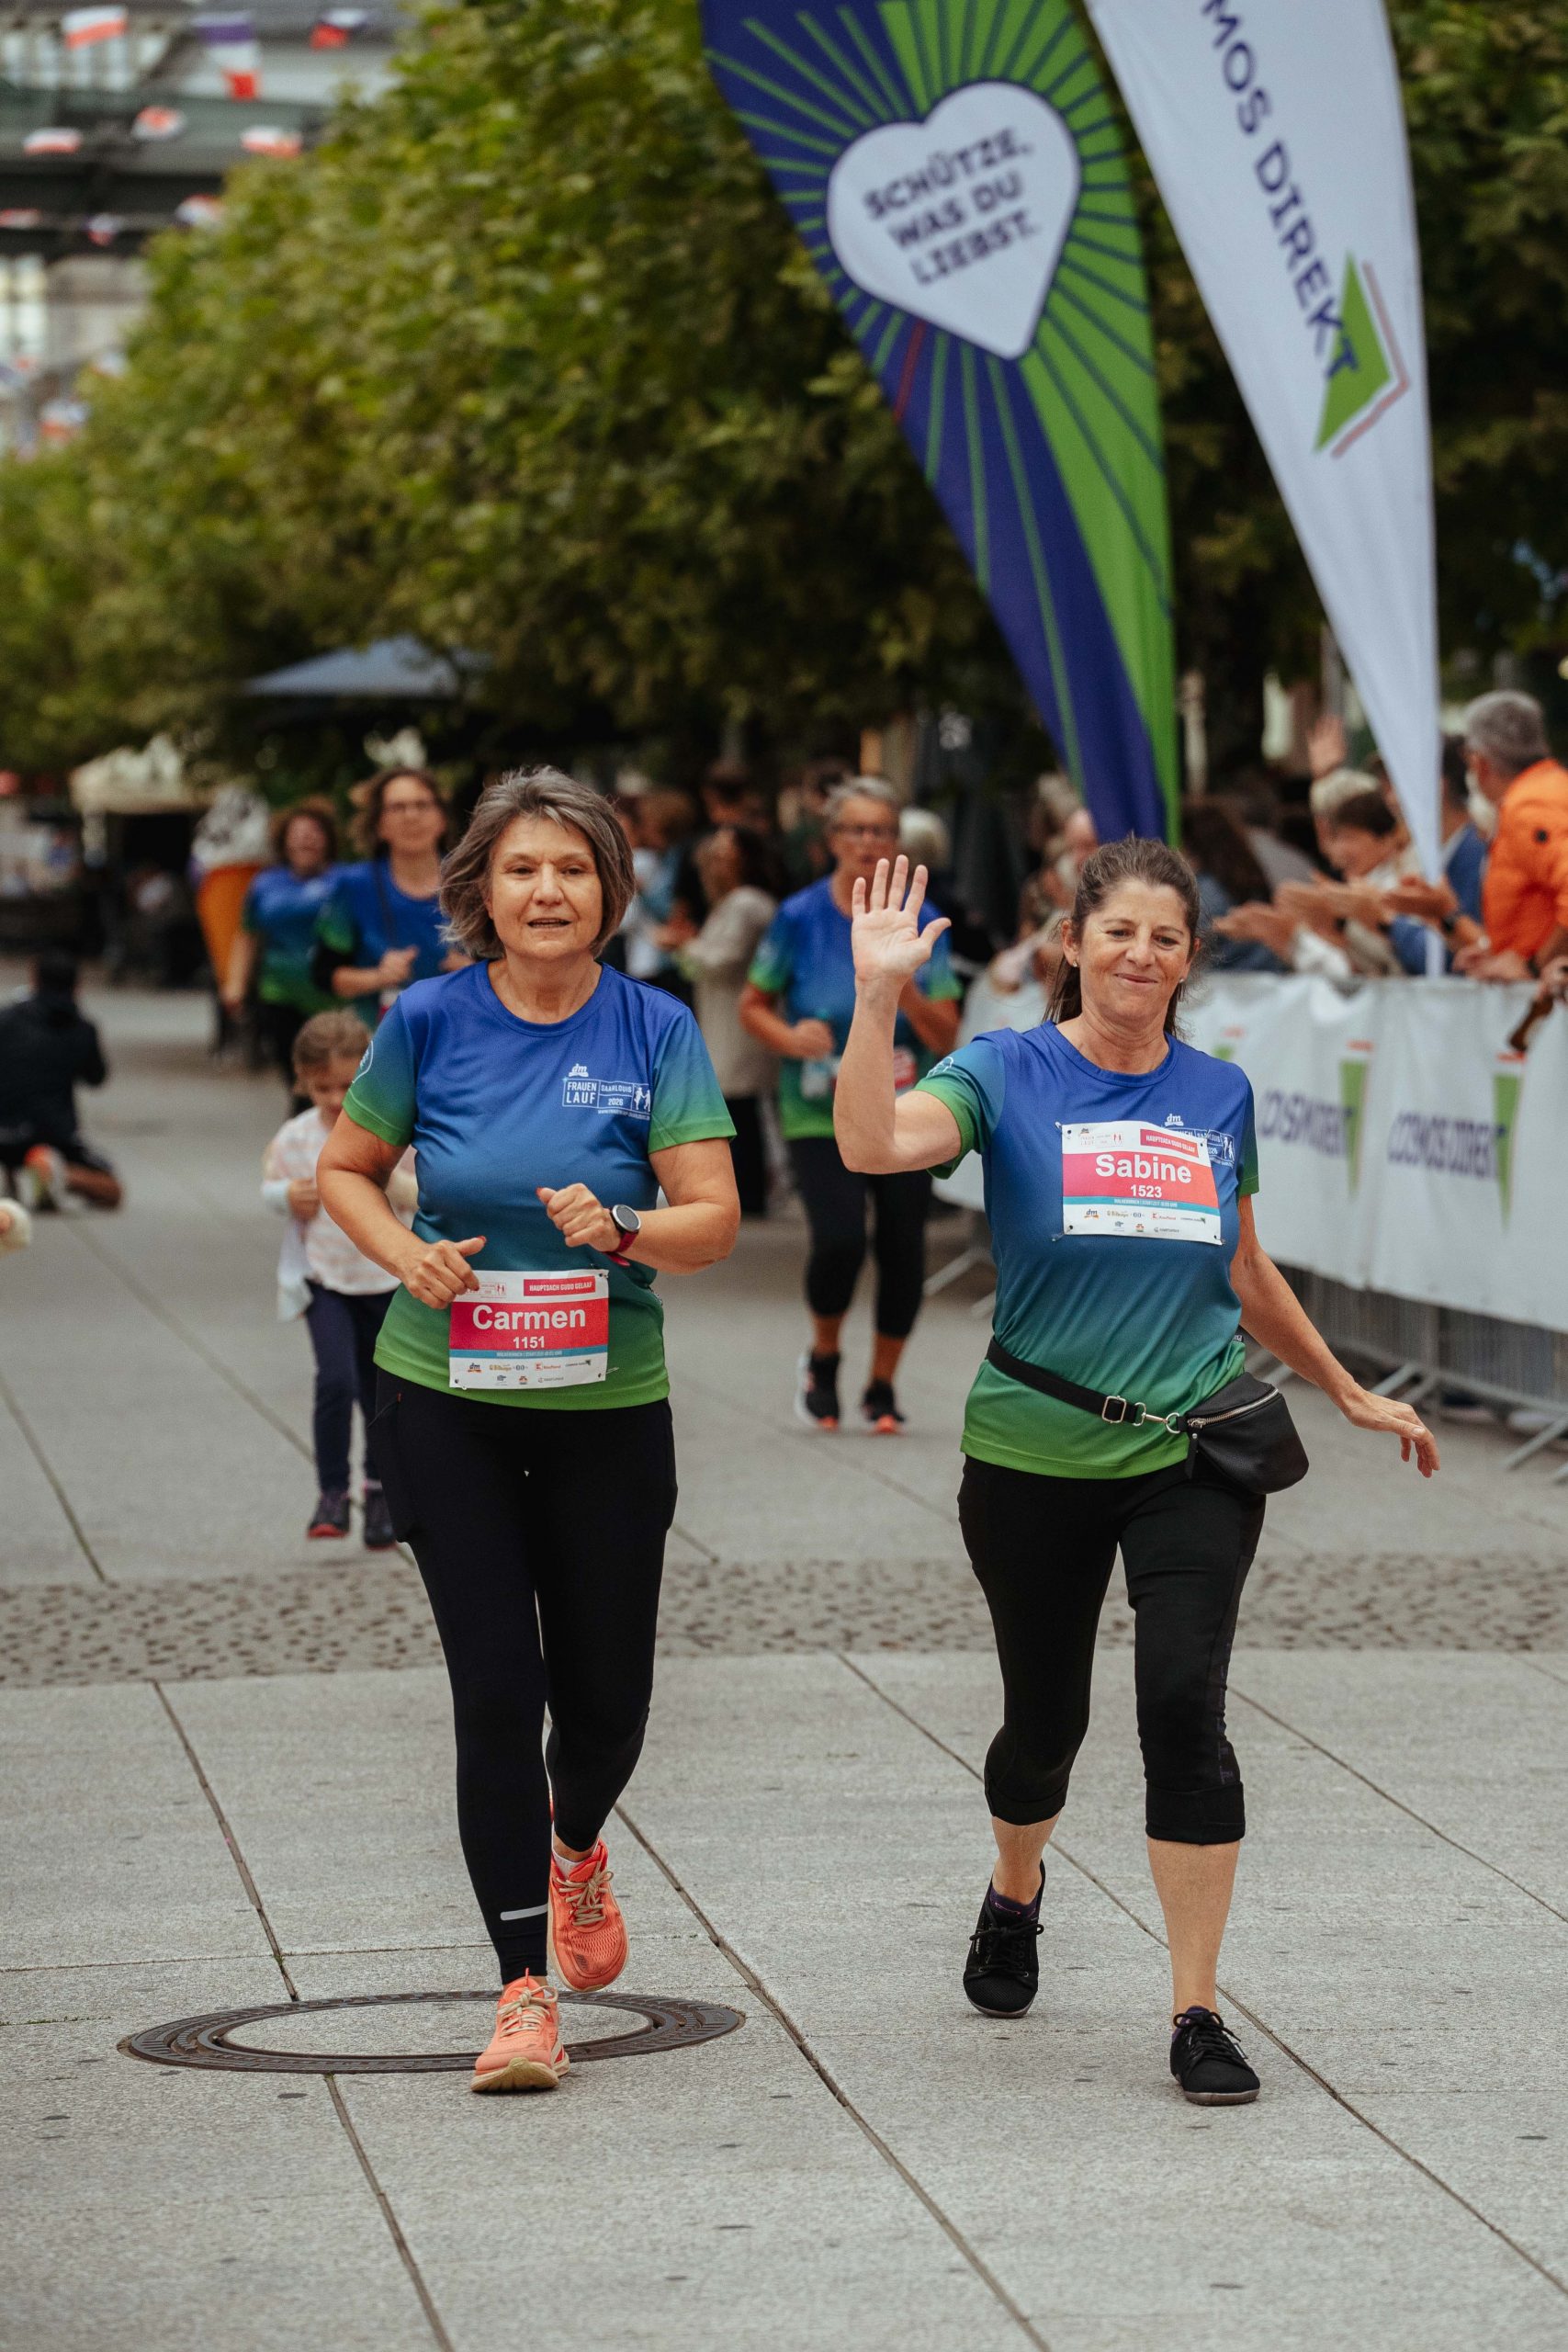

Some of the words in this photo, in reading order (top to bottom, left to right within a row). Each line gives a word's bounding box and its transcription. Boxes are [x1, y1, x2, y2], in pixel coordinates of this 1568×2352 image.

[888, 198, 964, 249] WAS
[970, 171, 1022, 213] DU
[1254, 139, 1359, 379] DIREKT
[567, 1081, 597, 1091] FRAUEN
[601, 1084, 632, 1093] SAARLOUIS
[566, 1091, 596, 1104] LAUF
[1166, 1114, 1182, 1124] dm
[1095, 1154, 1191, 1183] Sabine
[1130, 1184, 1162, 1198] 1523
[472, 1305, 586, 1329] Carmen
[513, 1336, 545, 1349] 1151
